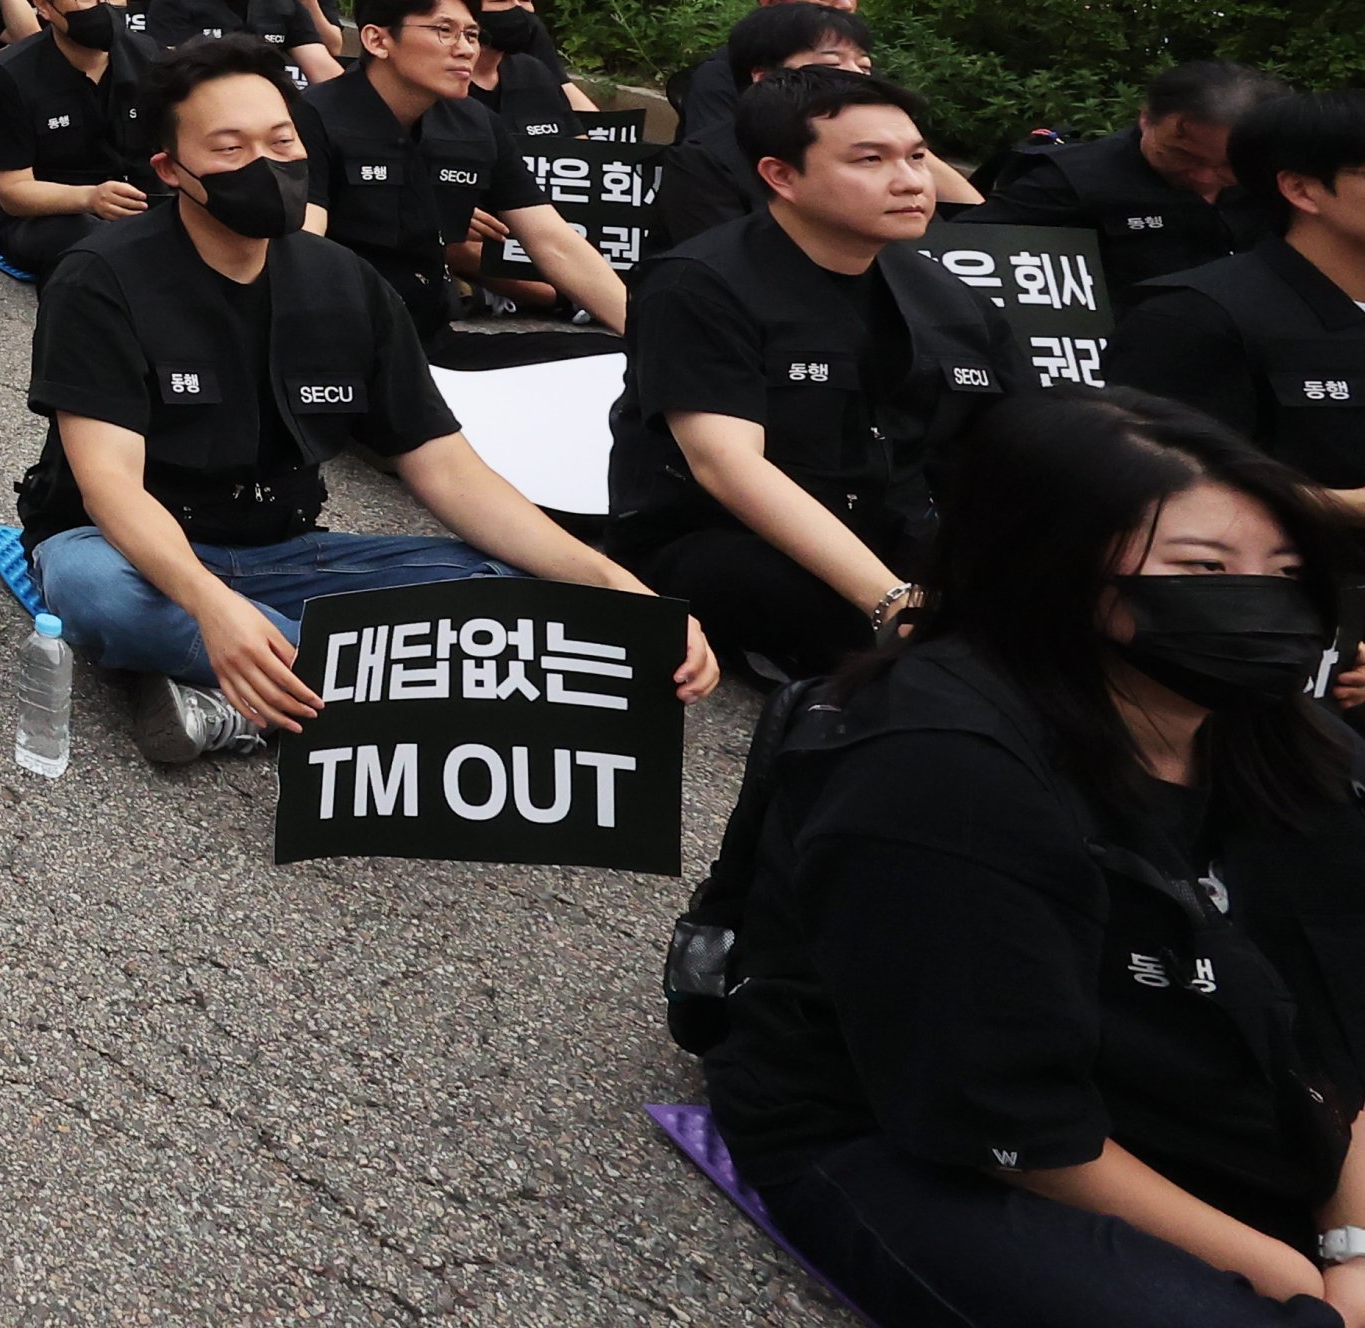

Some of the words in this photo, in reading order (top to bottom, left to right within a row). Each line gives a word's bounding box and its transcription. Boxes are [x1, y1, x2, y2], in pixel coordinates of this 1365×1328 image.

[47, 115, 70, 130] 동행
[526, 123, 559, 136] SECU
[360, 165, 387, 181] 동행
[439, 168, 478, 185] SECU
[1127, 215, 1164, 230] 동행
[1009, 251, 1097, 311] 회사
[788, 362, 829, 382] 동행
[953, 367, 989, 386] SECU
[170, 373, 200, 394] 동행
[1303, 380, 1350, 400] 동행
[300, 386, 353, 404] SECU
[323, 618, 633, 710] 대답없는
[308, 743, 419, 820] TM
[443, 743, 636, 828] OUT
